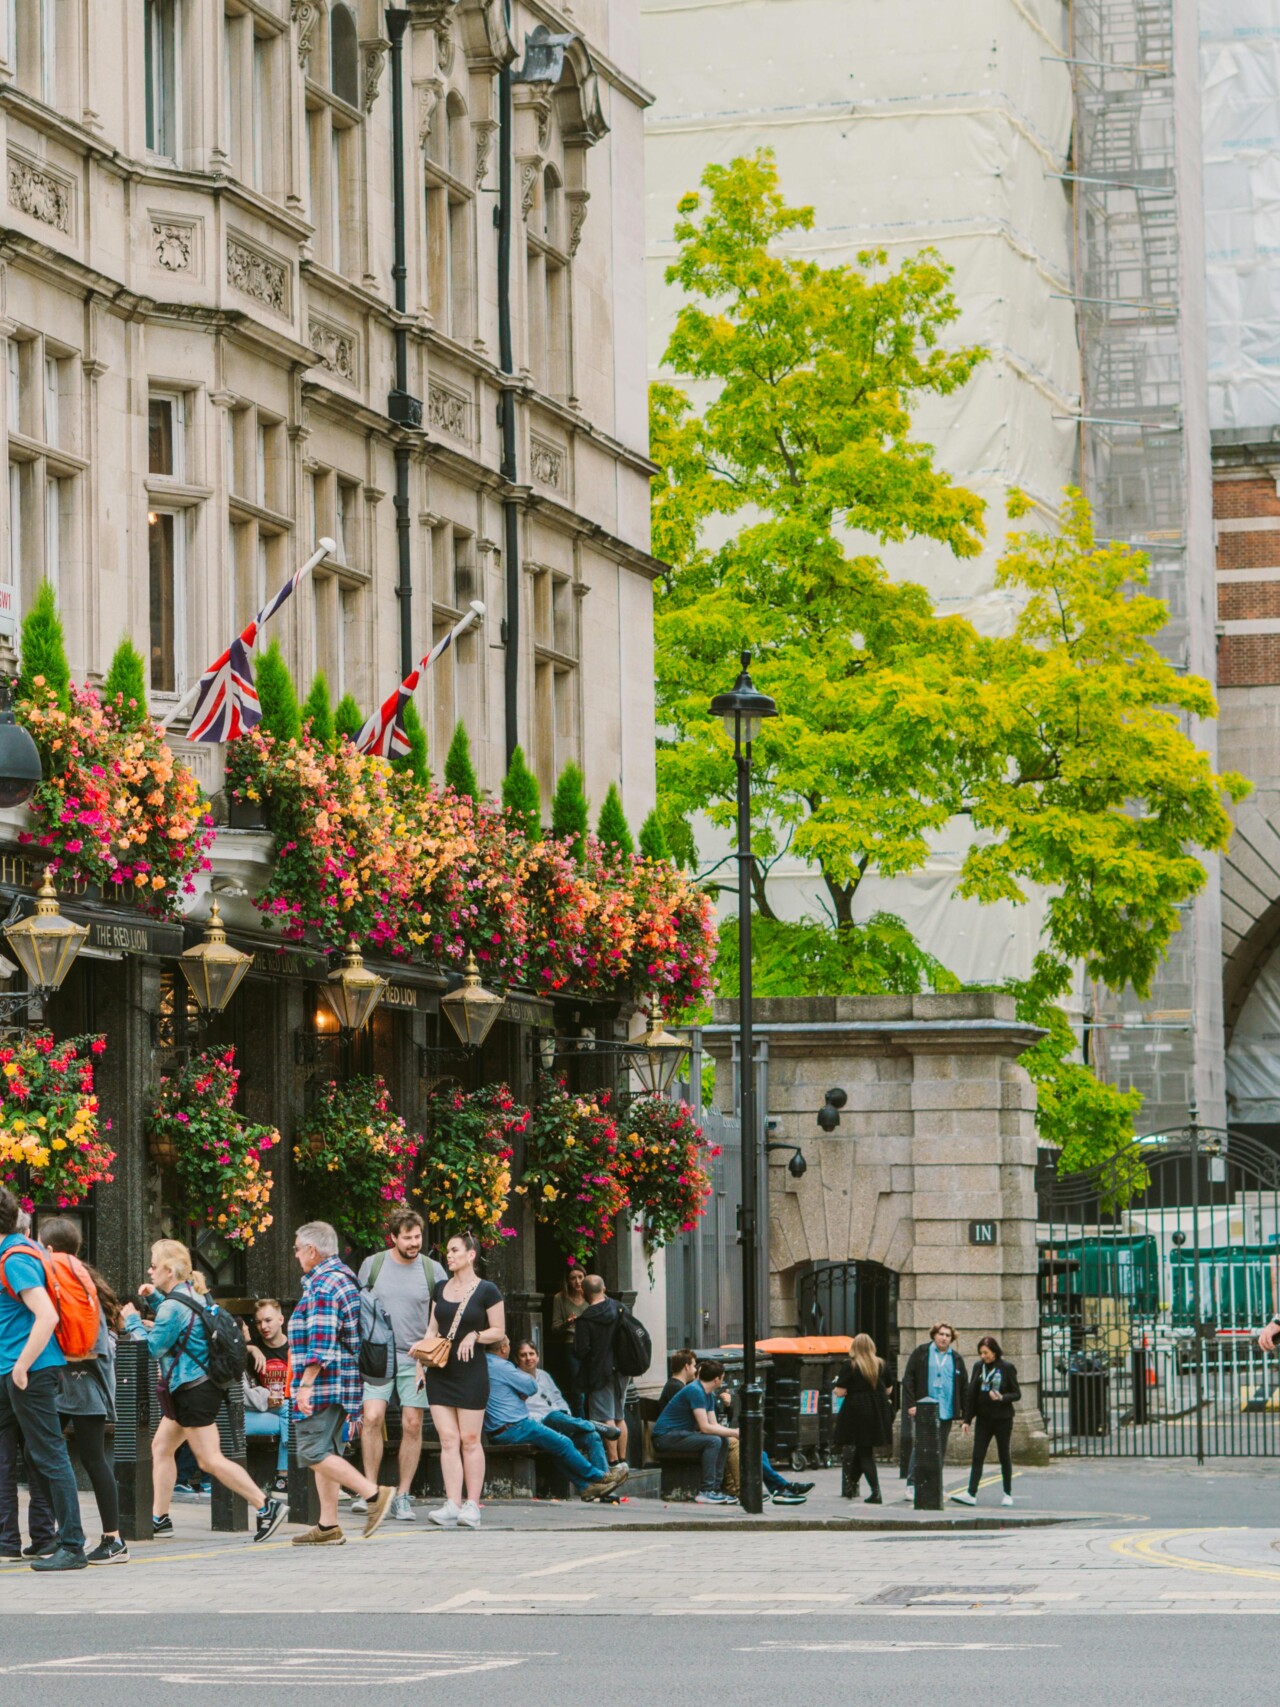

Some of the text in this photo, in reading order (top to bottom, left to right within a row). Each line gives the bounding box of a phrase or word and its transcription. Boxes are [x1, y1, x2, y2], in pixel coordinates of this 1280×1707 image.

[96, 924, 148, 950] THE RED LION
[386, 985, 400, 1004] RED
[401, 987, 417, 1007] LION
[975, 1224, 992, 1241] IN
